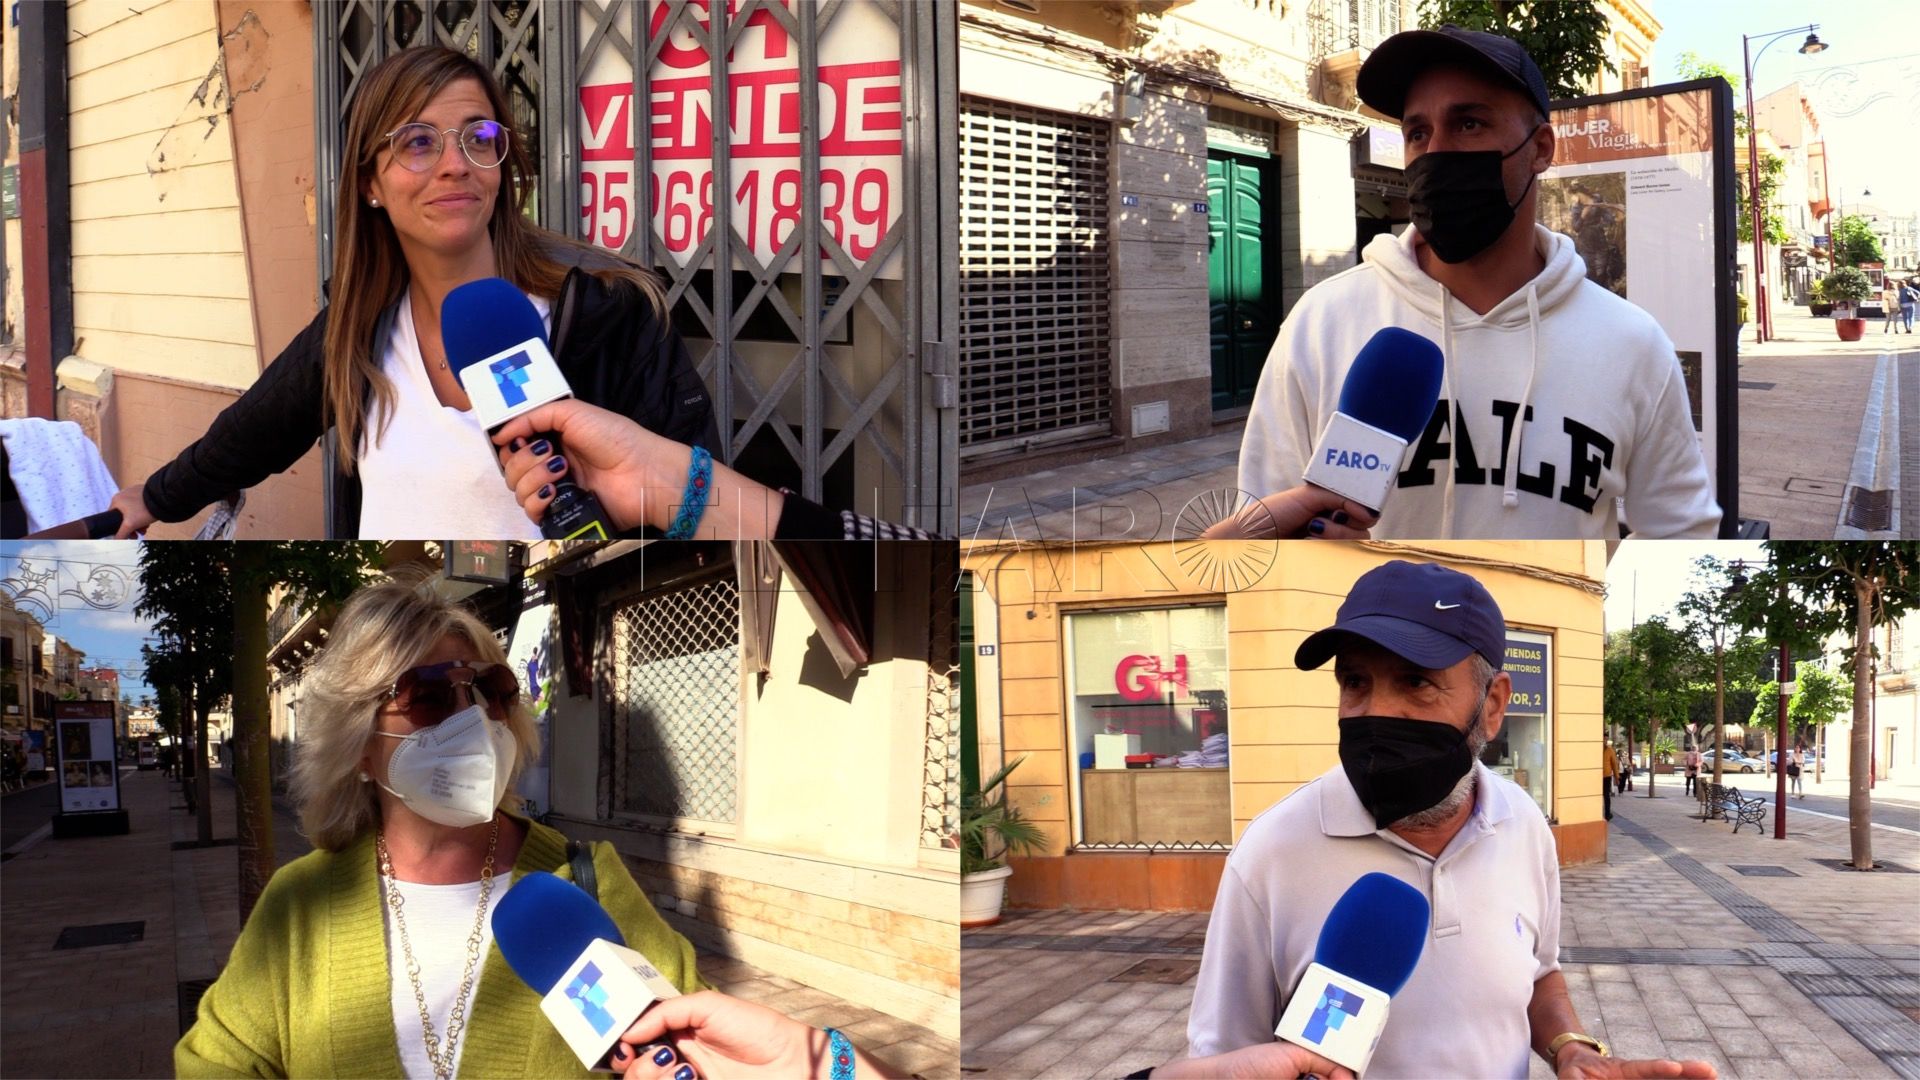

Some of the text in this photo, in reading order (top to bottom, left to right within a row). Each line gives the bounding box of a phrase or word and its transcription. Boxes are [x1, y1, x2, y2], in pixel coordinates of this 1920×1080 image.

[580, 75, 902, 150] VENDE
[1553, 119, 1609, 138] MUJER
[1326, 448, 1379, 470] FARO
[981, 646, 992, 655] 19
[1114, 654, 1190, 702] GH
[1501, 663, 1541, 674] RMITORIOS
[1534, 694, 1541, 706] 2
